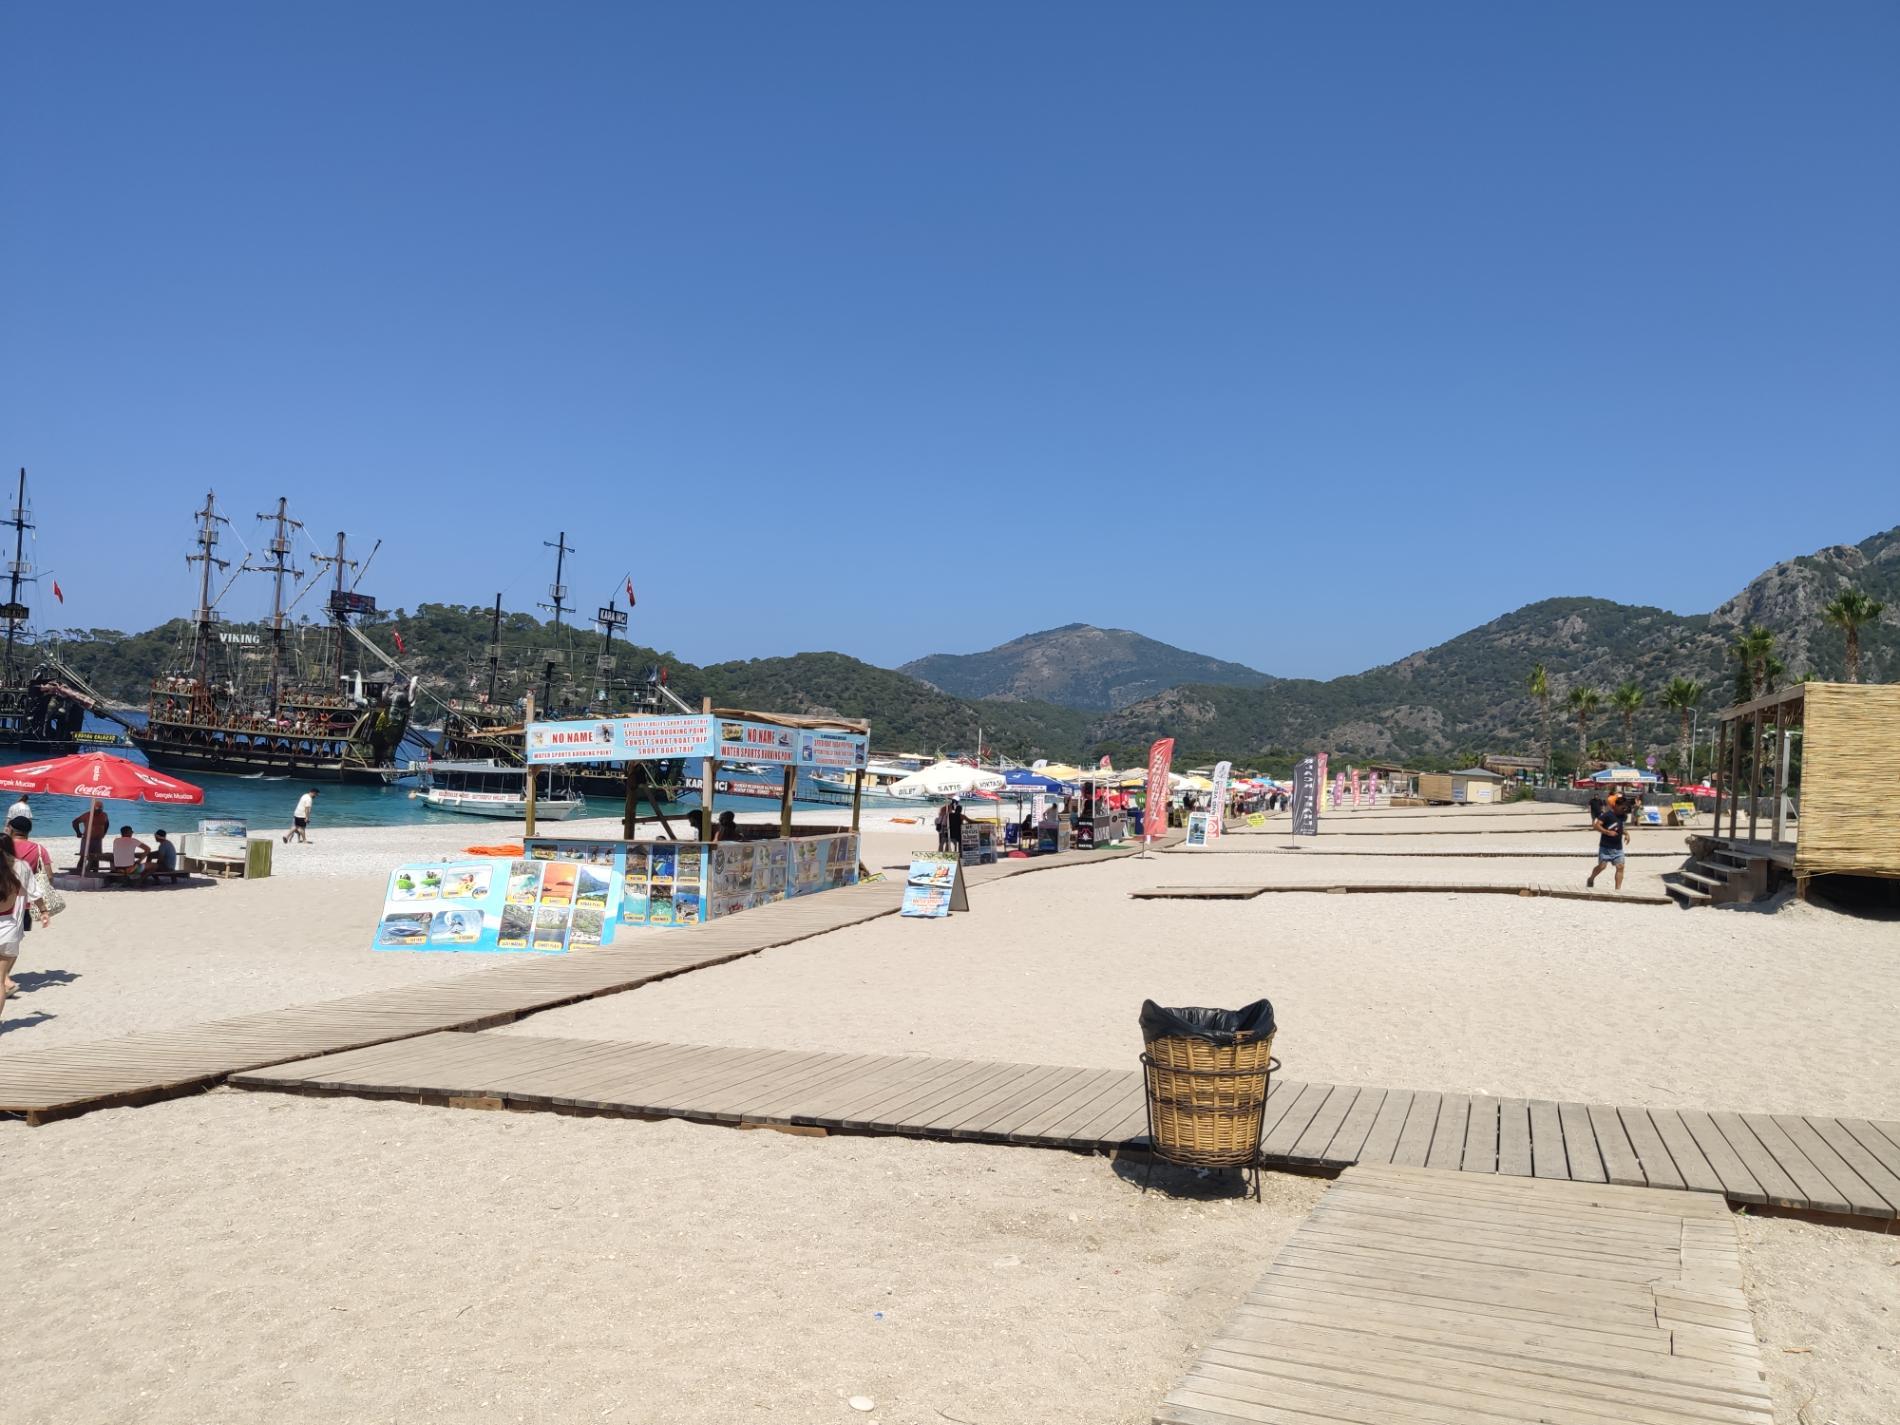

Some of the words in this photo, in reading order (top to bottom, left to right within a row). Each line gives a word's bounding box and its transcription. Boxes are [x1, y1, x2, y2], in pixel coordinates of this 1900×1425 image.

[219, 633, 260, 643] VIKING
[552, 733, 565, 743] NO
[567, 732, 593, 742] NAME
[747, 728, 757, 742] NO
[758, 729, 775, 744] NAME
[721, 746, 740, 757] WATER
[740, 747, 761, 759] SPORTS
[685, 778, 703, 788] KAR
